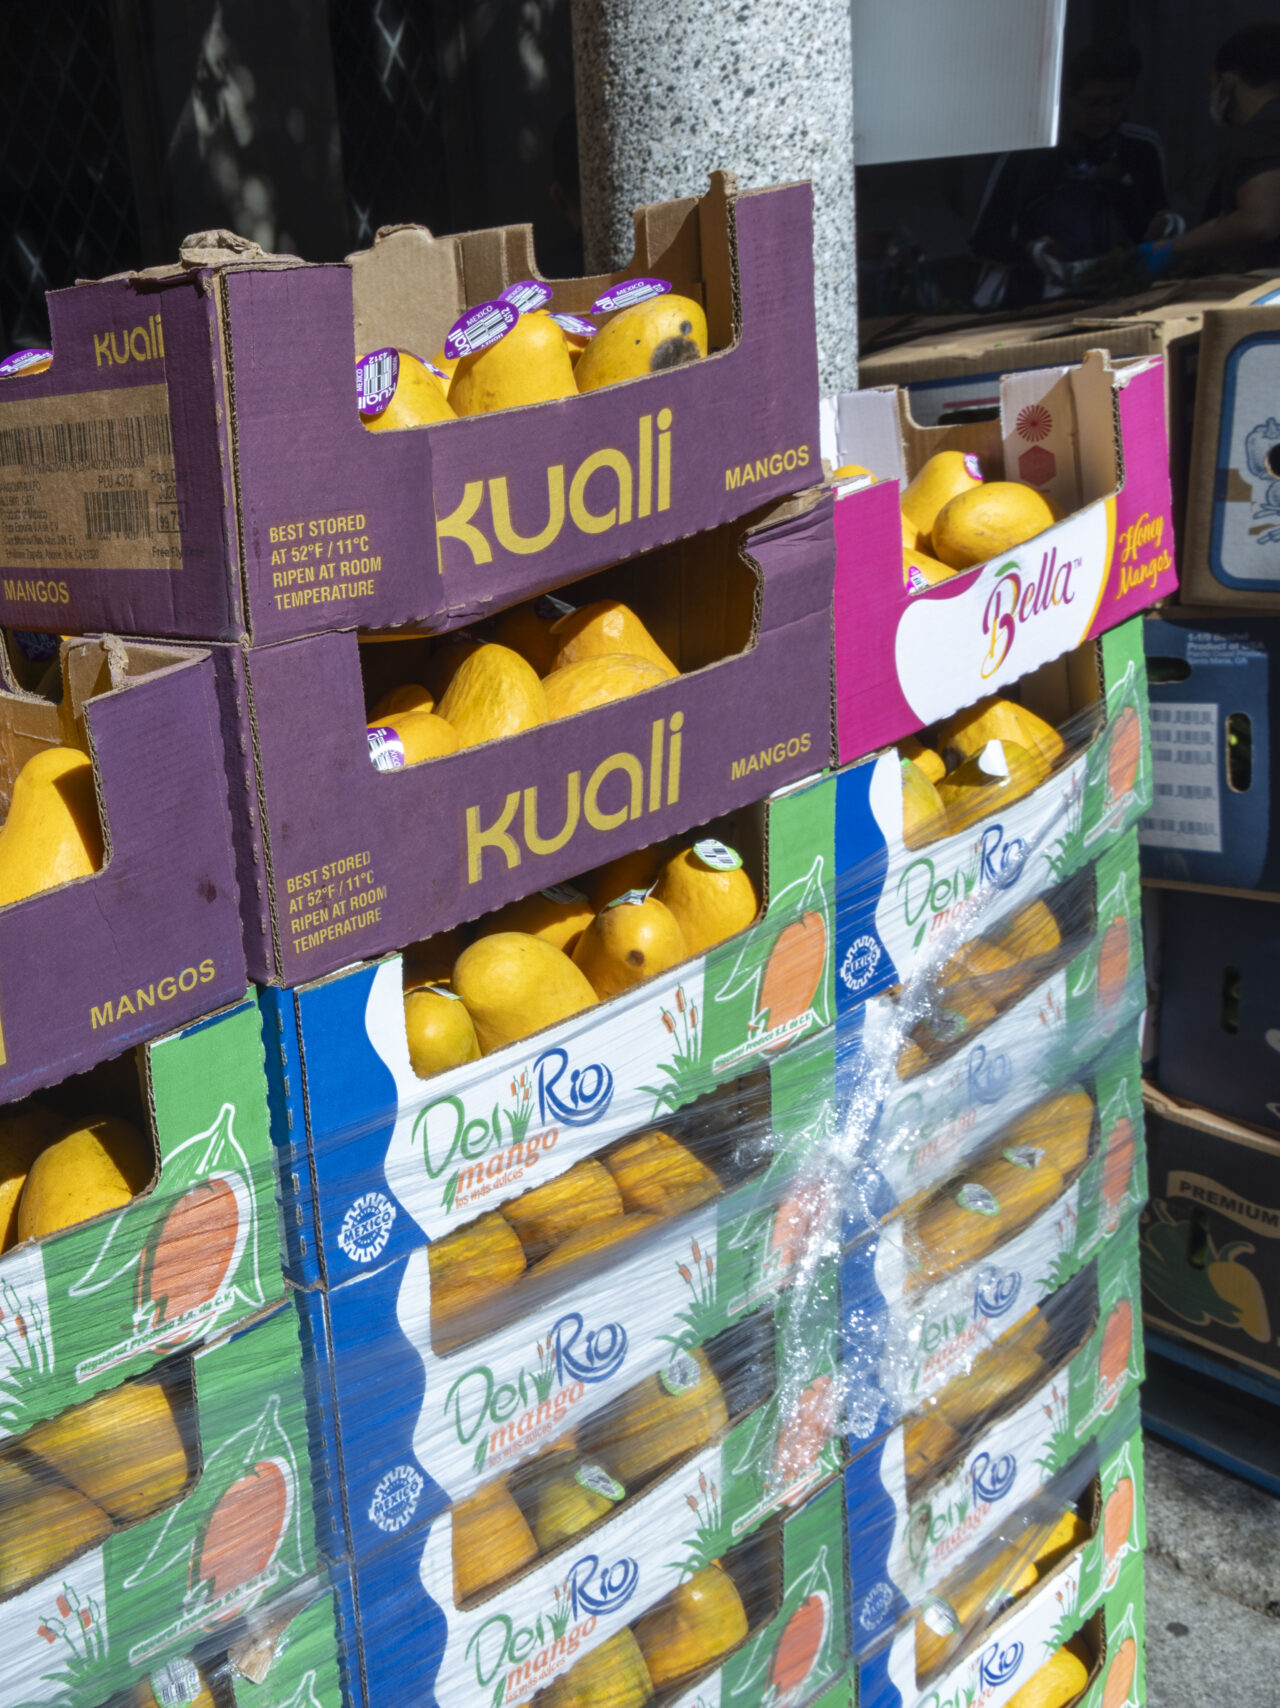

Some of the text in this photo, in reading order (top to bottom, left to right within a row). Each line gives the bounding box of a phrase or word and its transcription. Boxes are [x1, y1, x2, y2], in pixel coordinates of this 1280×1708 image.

[616, 281, 645, 297] MEXICO
[466, 305, 494, 327] MEXICO
[500, 306, 515, 324] 4312
[93, 314, 166, 368] Kuali
[368, 351, 389, 365] 4312
[355, 368, 364, 393] MEXICO
[98, 473, 134, 488] PLU 4312
[436, 407, 673, 575] Kuali
[724, 445, 810, 491] MANGOS
[269, 514, 366, 543] BEST STORED
[271, 549, 287, 566] AT
[291, 542, 323, 562] 52°F
[336, 536, 369, 555] 11°C
[1120, 512, 1164, 562] Honey
[3, 579, 70, 603] MANGOS
[273, 556, 382, 588] RIPEN AT ROOM
[274, 579, 375, 610] TEMPERATURE
[1115, 550, 1171, 600] Mangos
[981, 546, 1075, 680] Bella
[1187, 641, 1227, 650] Product
[730, 732, 812, 782] MANGOS
[465, 711, 685, 884] Kuali
[286, 850, 371, 894] BEST STORED
[289, 895, 304, 914] AT
[307, 884, 336, 907] 52°F
[346, 870, 375, 891] 11°C
[290, 885, 388, 935] RIPEN AT ROOM
[292, 907, 383, 954] TEMPERATURE
[89, 957, 216, 1029] MANGOS
[533, 1048, 615, 1127] Rio
[457, 1126, 559, 1194] mango
[344, 1212, 391, 1245] MEXICO
[1179, 1181, 1278, 1228] PREMIUM
[551, 1312, 629, 1387] Rio
[489, 1381, 585, 1452] mango
[971, 1452, 1017, 1508] Rio
[934, 1502, 992, 1560] mango
[567, 1554, 639, 1622] Rio
[506, 1614, 597, 1691] mango
[977, 1641, 1024, 1693] Rio
